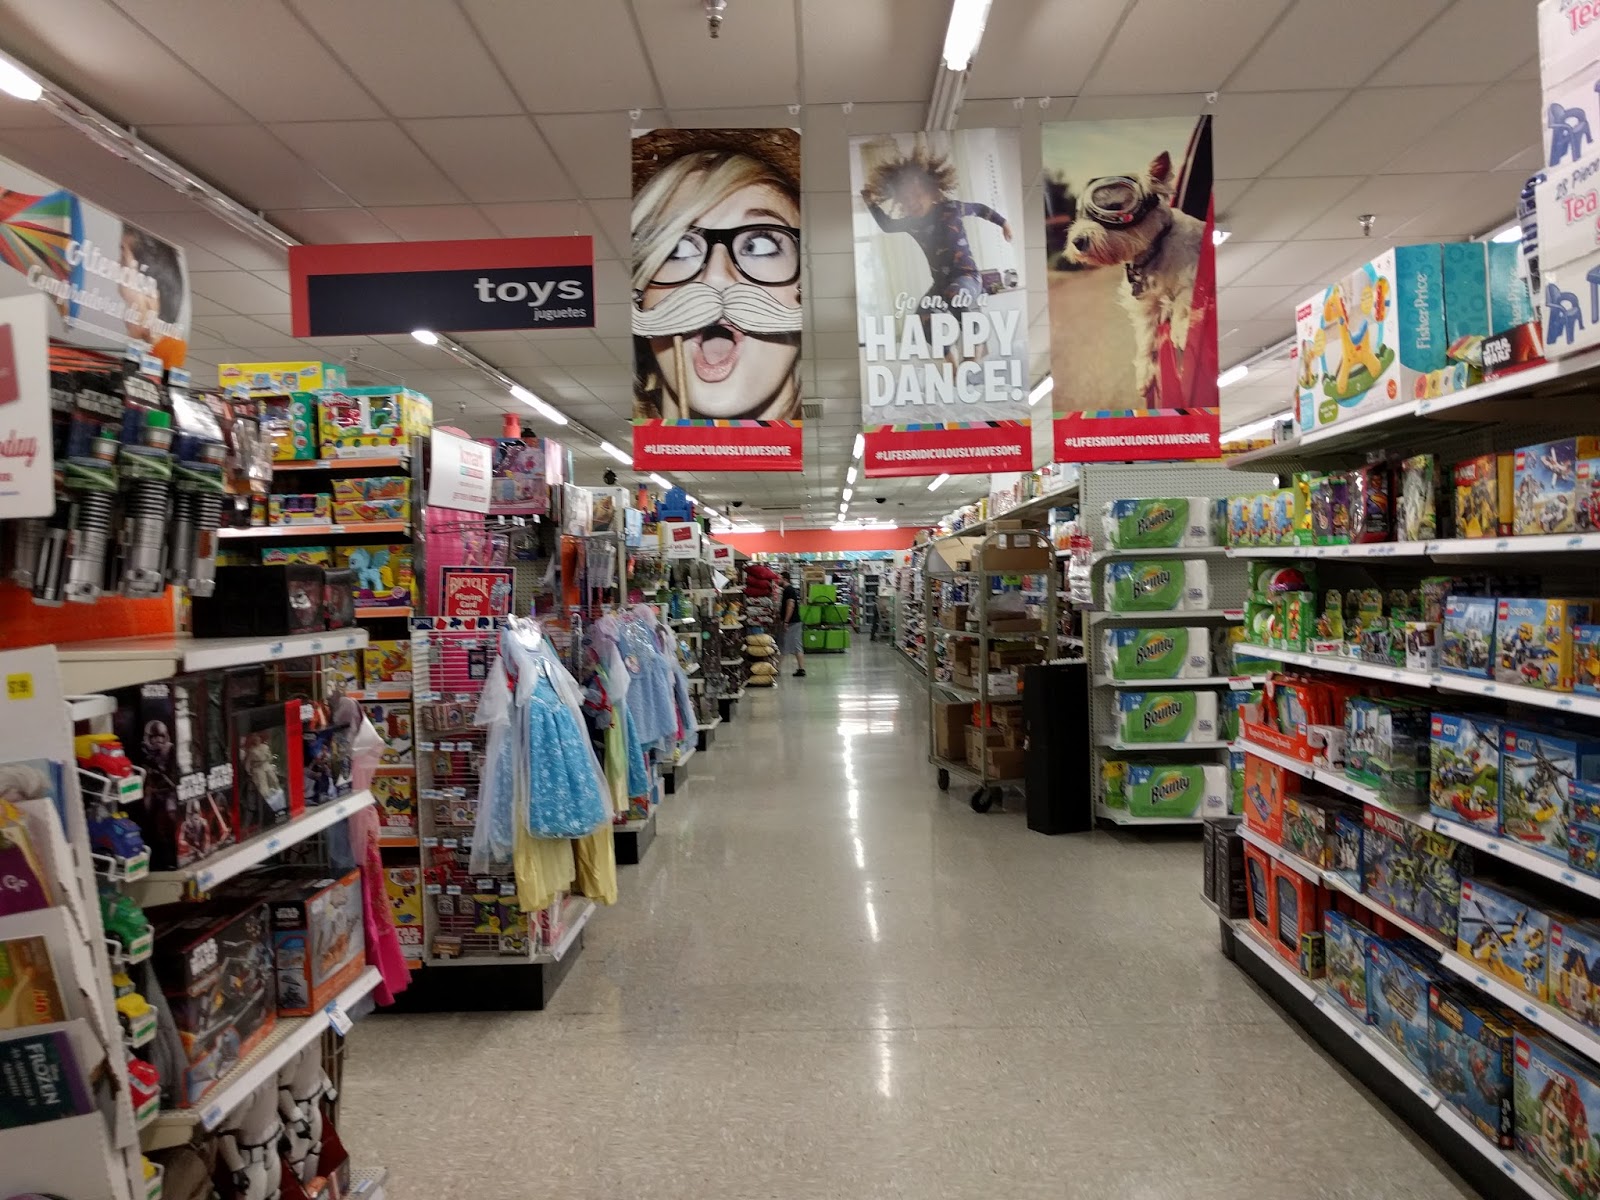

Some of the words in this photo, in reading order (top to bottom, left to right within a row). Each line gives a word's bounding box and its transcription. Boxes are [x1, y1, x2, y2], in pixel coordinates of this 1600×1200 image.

[1564, 192, 1598, 222] Tea
[474, 278, 584, 307] toys
[895, 292, 915, 319] Go
[921, 295, 948, 310] on,
[951, 288, 973, 308] do
[976, 293, 990, 307] a
[533, 307, 587, 321] juguetes
[865, 310, 1021, 362] HAPPY
[867, 359, 1024, 407] DANCE!
[1064, 433, 1210, 448] #LIFEISRIDICULOUSLYAWESOME
[1137, 508, 1174, 535] Bounty
[1133, 571, 1170, 599] Bounty
[1136, 638, 1174, 665] Bounty
[1143, 701, 1182, 731] Bounty
[1151, 776, 1190, 805] Bounty
[24, 1043, 61, 1104] FROZEN
